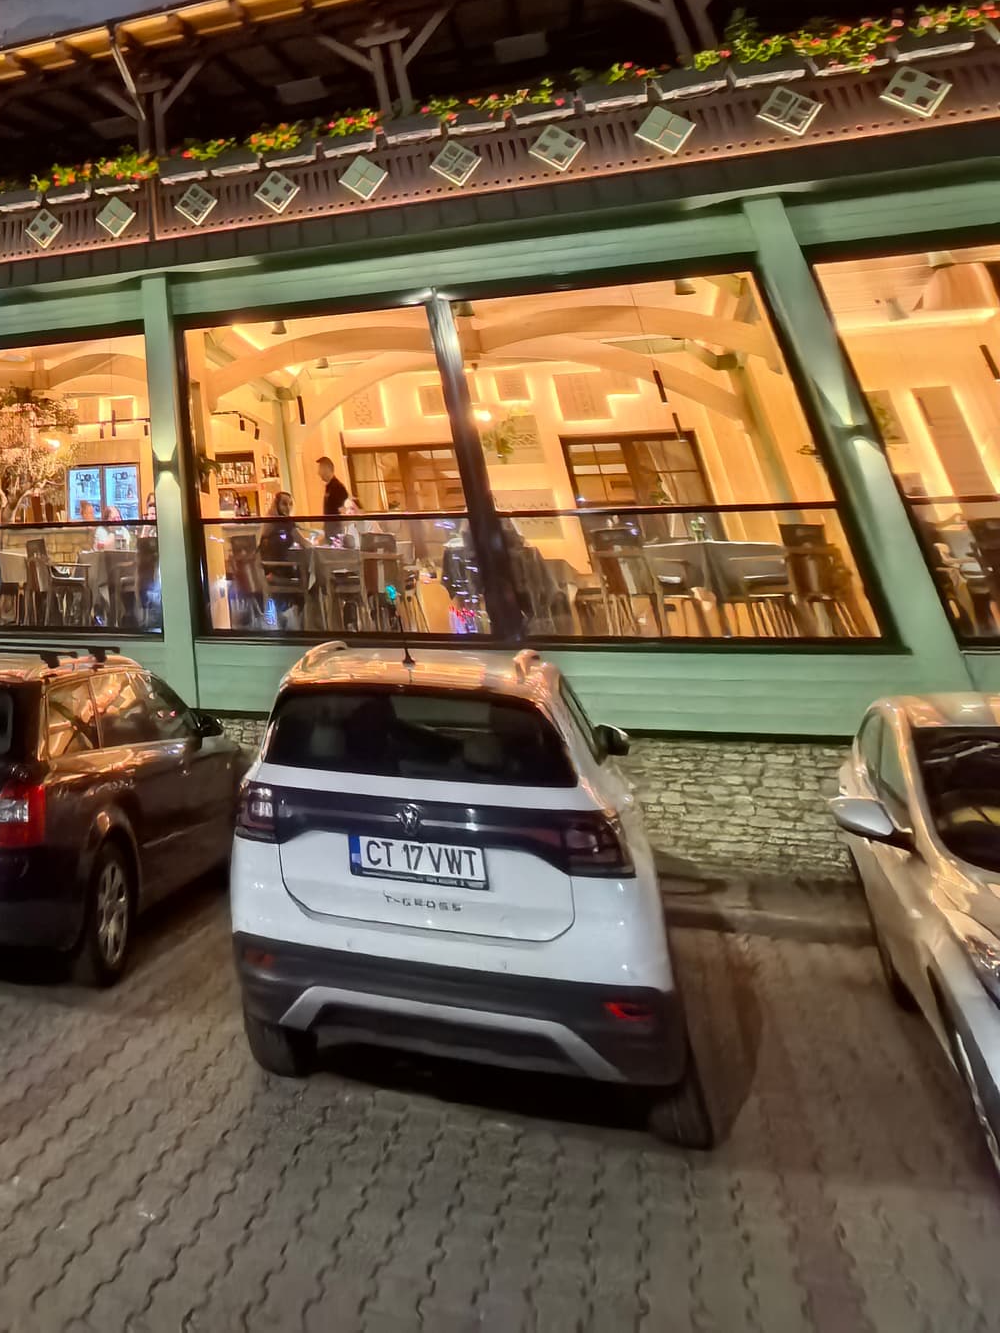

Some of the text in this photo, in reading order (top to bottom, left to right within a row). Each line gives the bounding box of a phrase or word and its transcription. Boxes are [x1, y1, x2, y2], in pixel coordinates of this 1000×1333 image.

[366, 840, 476, 877] CT 17 VWT
